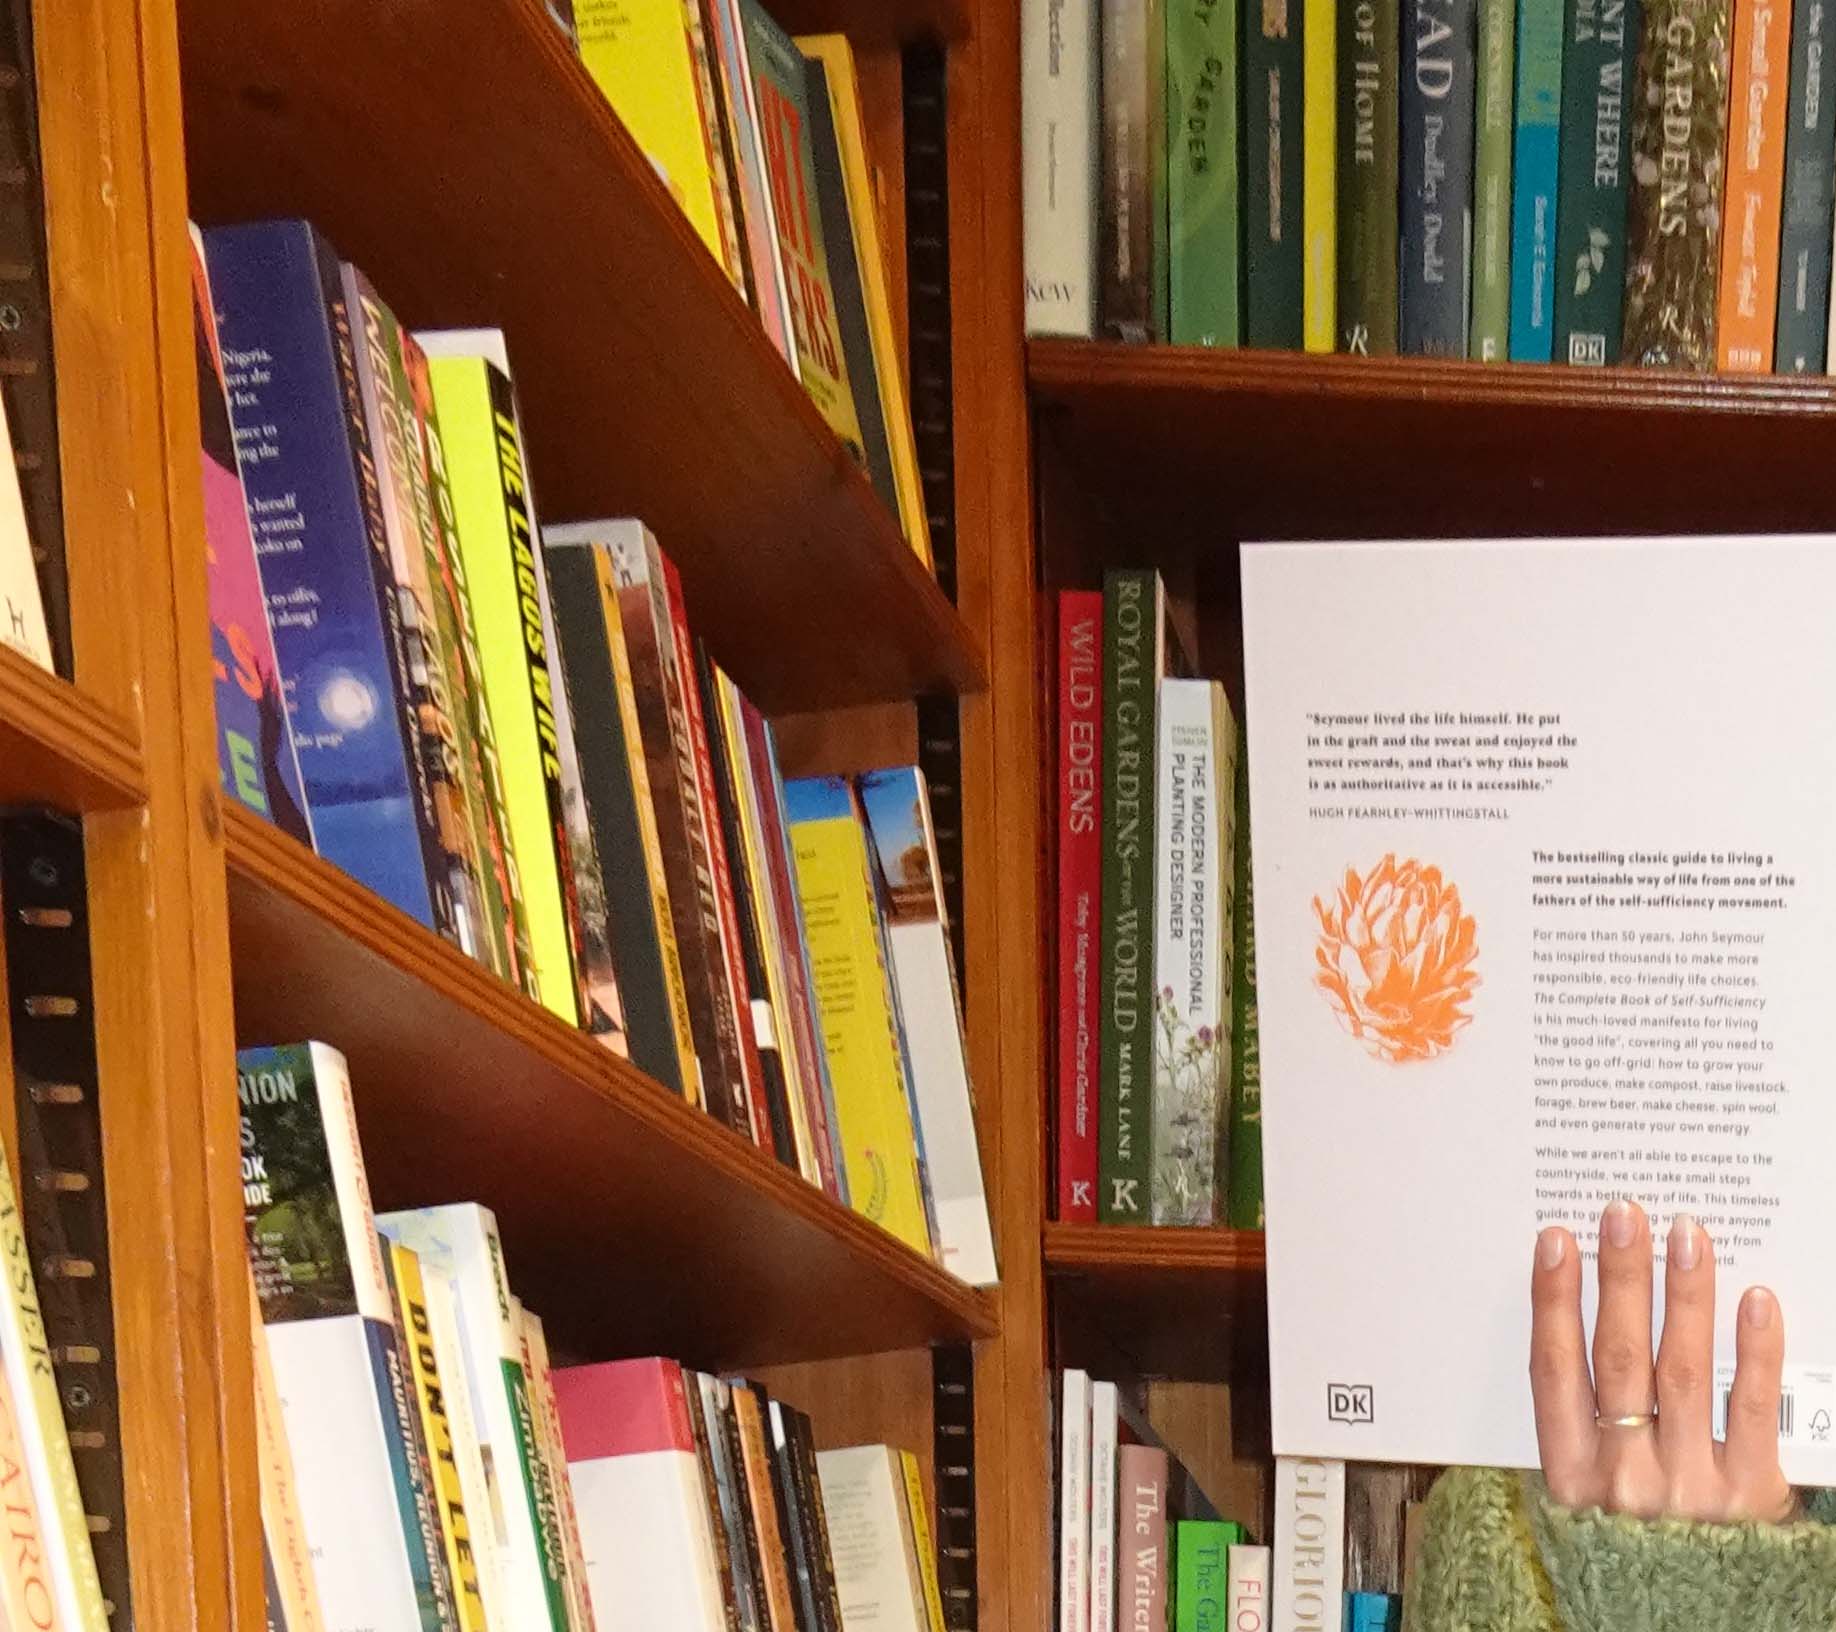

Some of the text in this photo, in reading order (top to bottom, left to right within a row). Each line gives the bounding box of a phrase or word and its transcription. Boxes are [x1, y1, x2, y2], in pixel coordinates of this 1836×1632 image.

[497, 412, 560, 779] THE LAGOS WIFE
[1068, 620, 1094, 834] WILD EDENS
[1114, 579, 1141, 1033] ROYAL GARDENS WORLD
[1309, 807, 1510, 820] HUGH FEARNLEY-WHITTINGSTALL
[1170, 753, 1186, 942] PLANTING DESIGNER
[1532, 851, 1773, 867] The bestselling classic guide to living a
[1189, 756, 1206, 1015] THE MODERN PROFESSIONAL
[1532, 873, 1795, 888] more sustainable way of life from one of the
[1532, 894, 1787, 910] fathers of the self-sufficiency movement.
[1135, 1482, 1158, 1537] The
[1196, 1546, 1219, 1591] The
